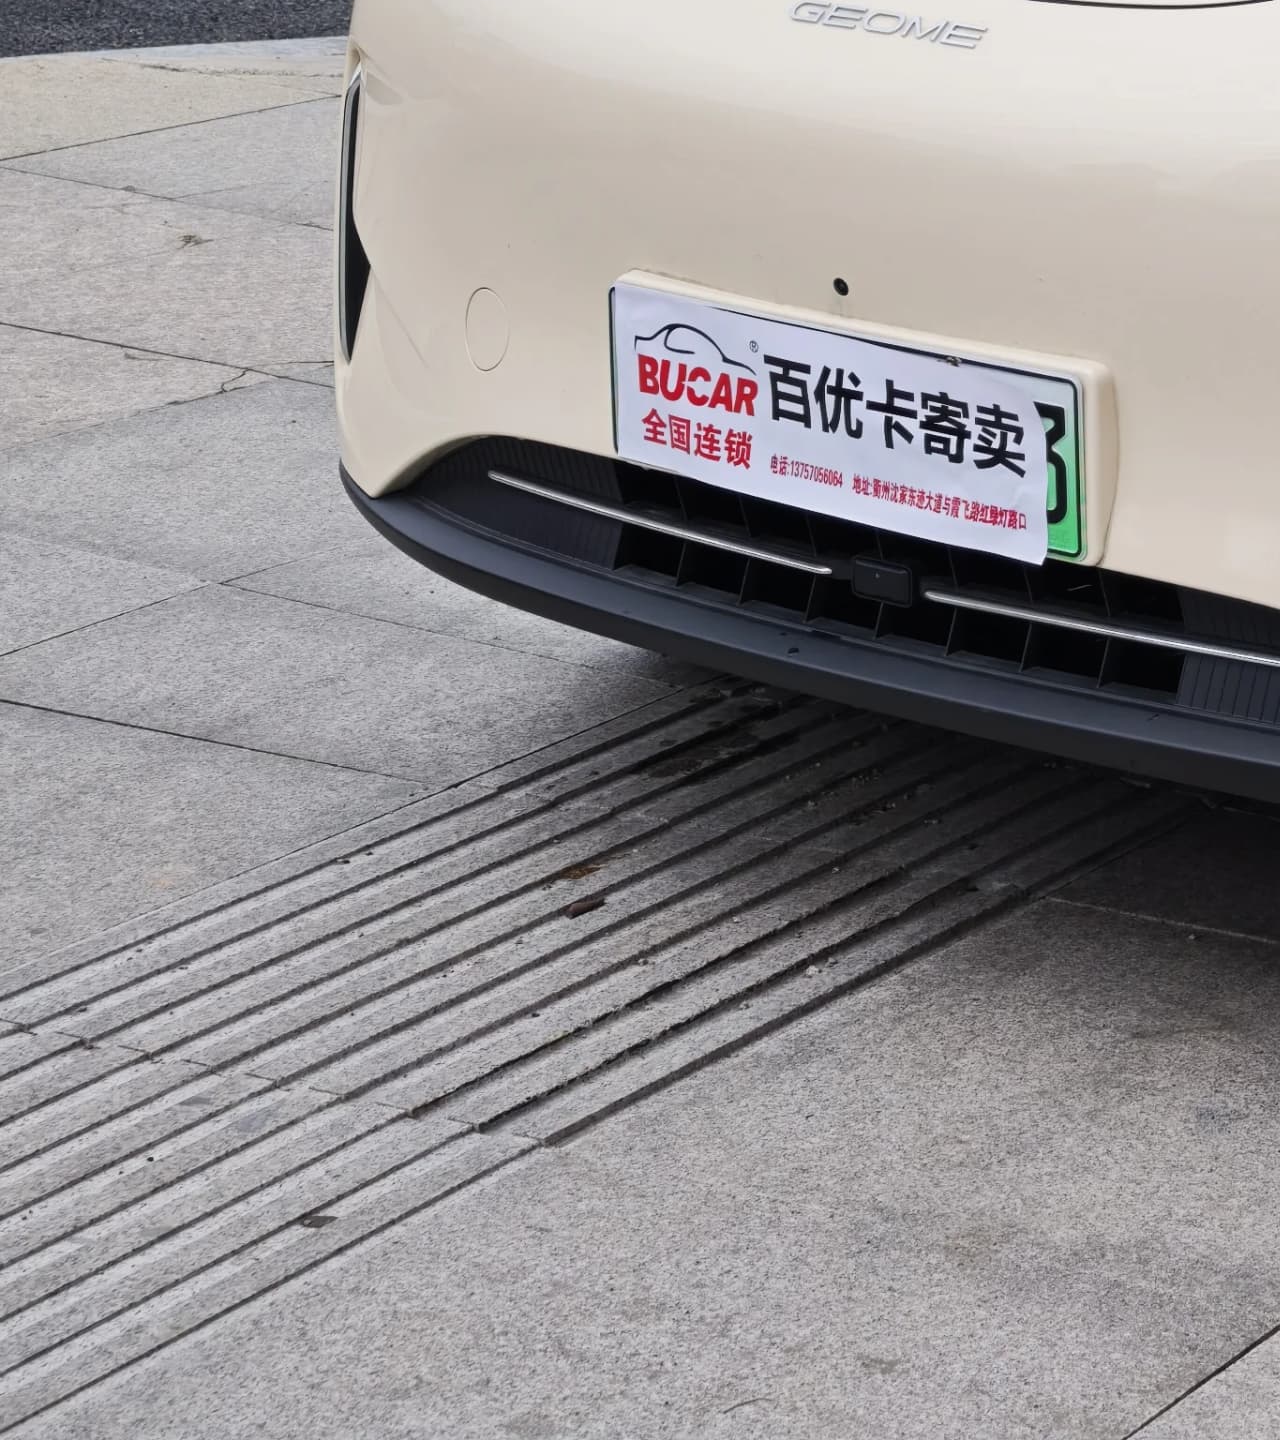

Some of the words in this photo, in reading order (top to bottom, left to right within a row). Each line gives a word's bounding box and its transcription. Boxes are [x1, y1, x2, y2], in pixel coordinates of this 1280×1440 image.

[790, 0, 990, 51] GEOME
[637, 353, 759, 417] BUCAR
[763, 354, 1028, 479] 百优卡寄卖
[641, 407, 752, 471] 全国连锁
